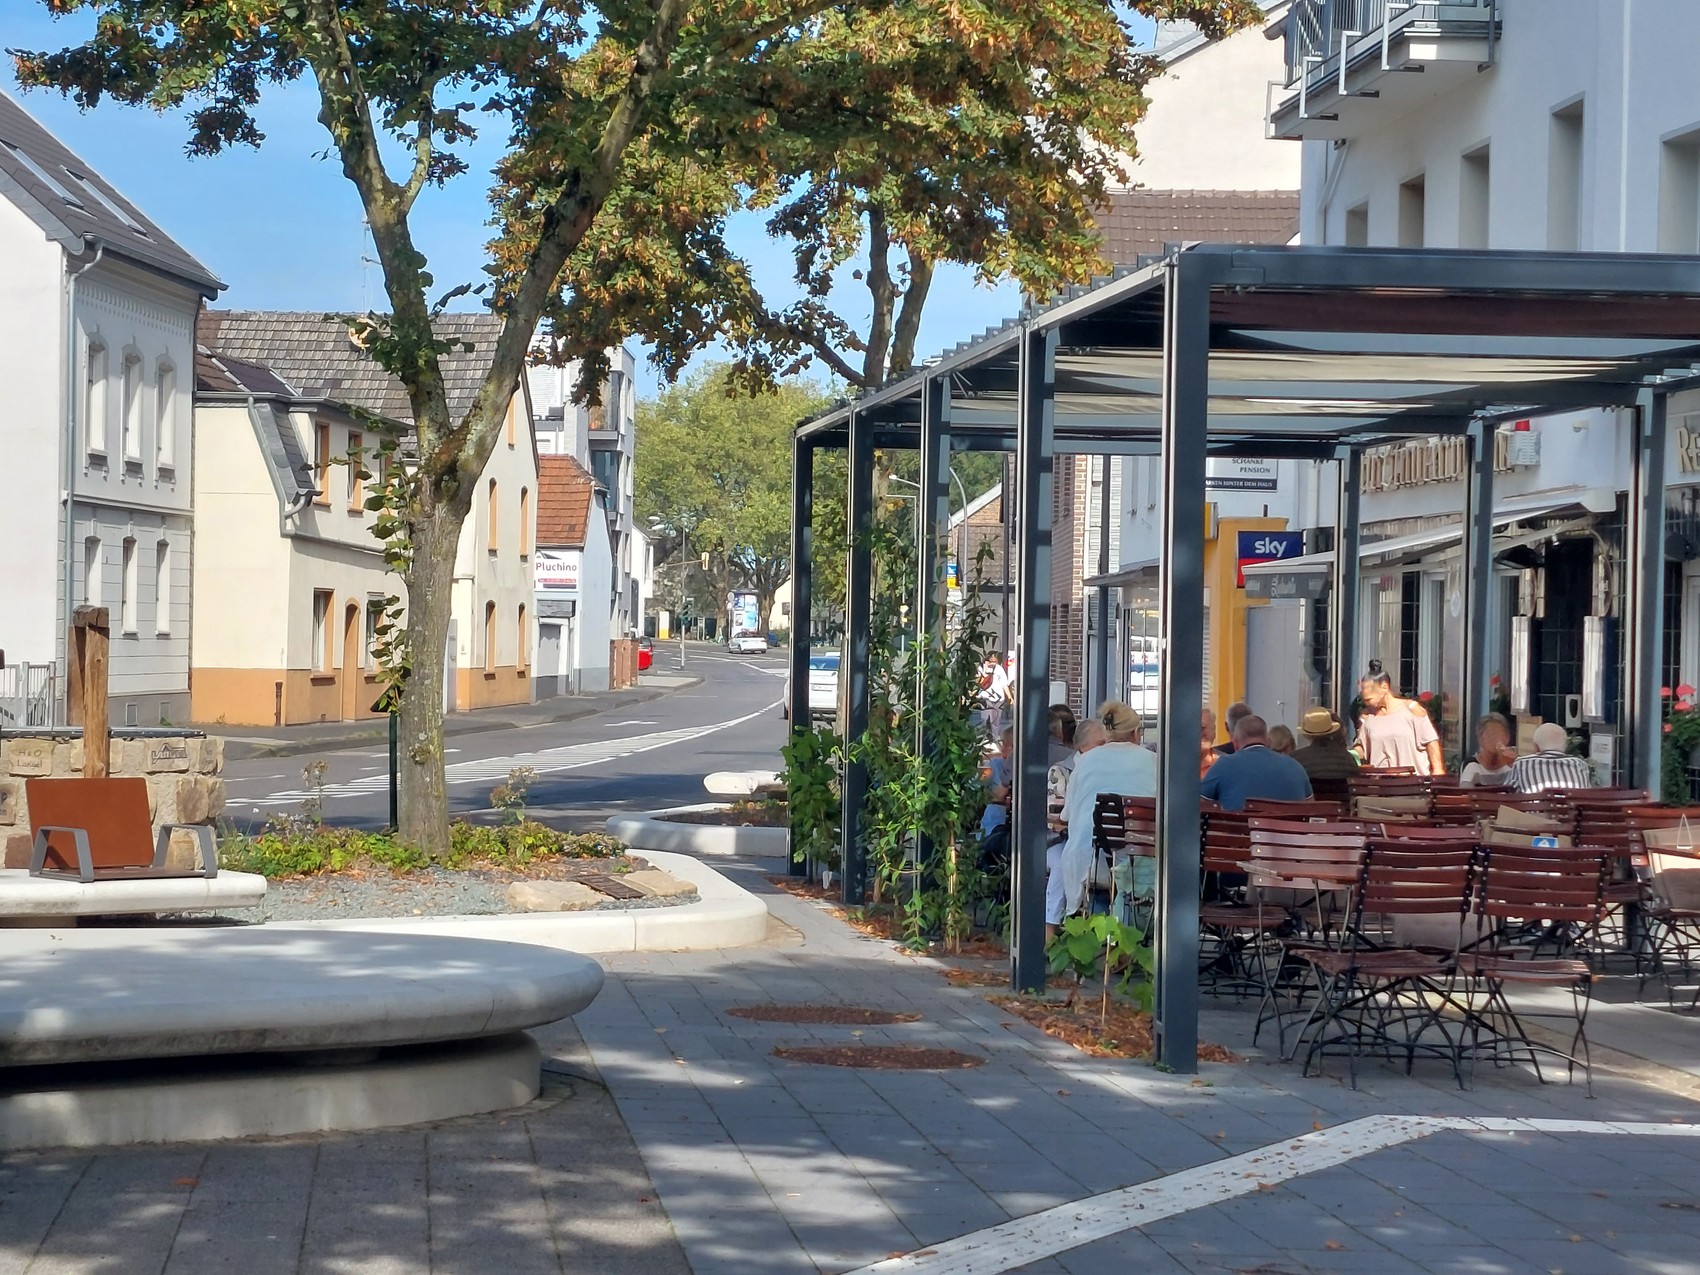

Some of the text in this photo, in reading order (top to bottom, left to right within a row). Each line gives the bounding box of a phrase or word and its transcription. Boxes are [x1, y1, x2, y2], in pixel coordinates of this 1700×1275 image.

[1239, 466, 1271, 474] PENSION
[1254, 537, 1288, 558] sky
[535, 562, 578, 572] Pluchino
